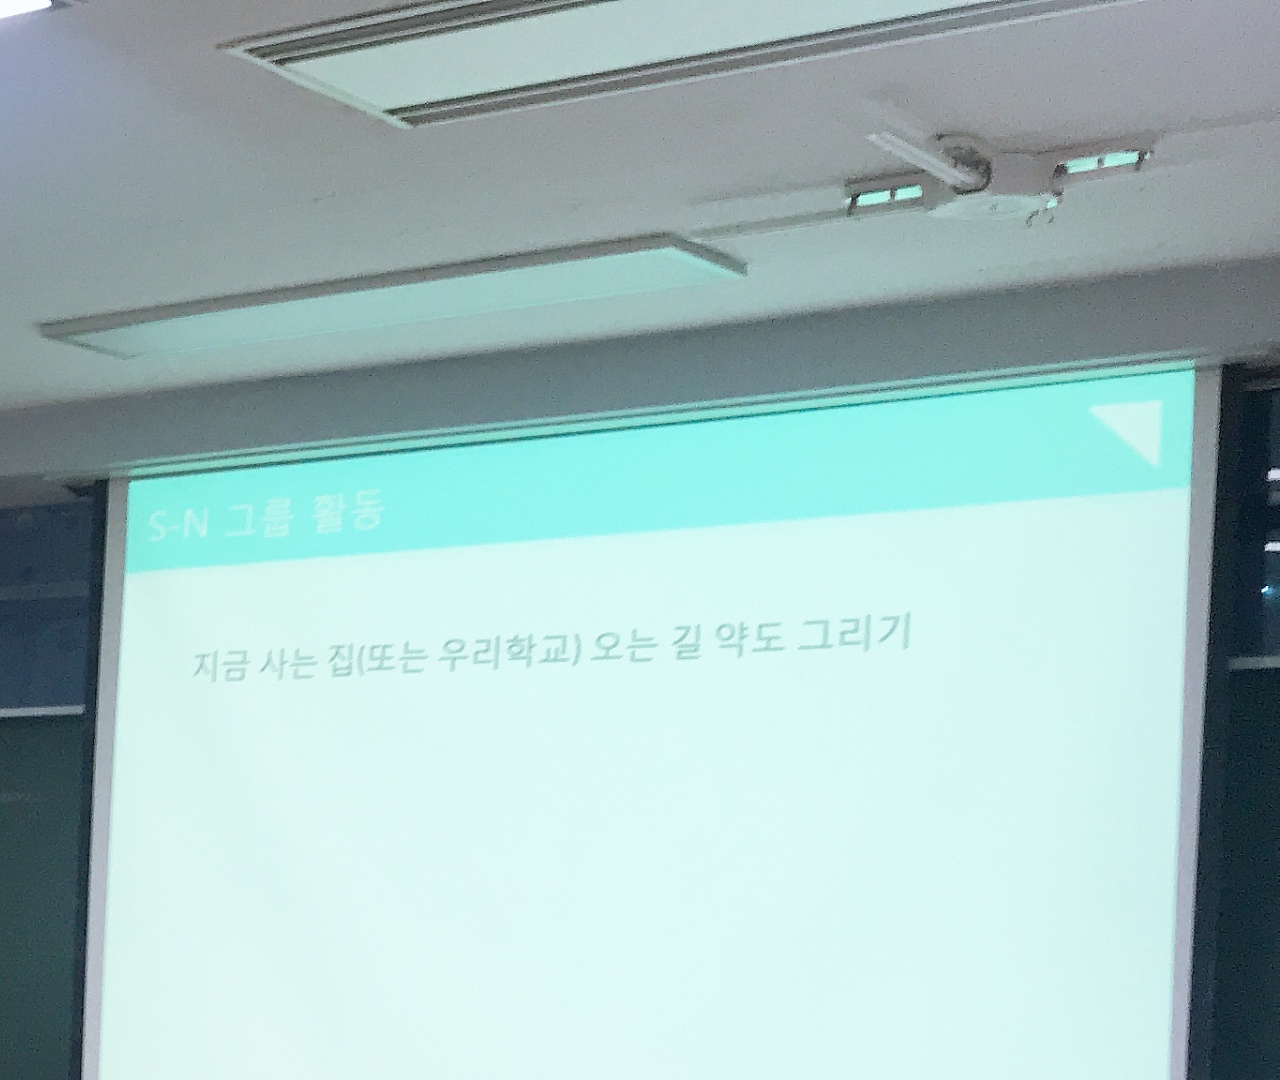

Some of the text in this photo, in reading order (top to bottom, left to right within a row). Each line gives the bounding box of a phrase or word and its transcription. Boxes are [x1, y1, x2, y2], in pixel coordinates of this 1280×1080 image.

[224, 497, 293, 538] 그룹
[313, 488, 385, 535] 활동
[192, 611, 911, 683] 지금 사는 집(또는 우리학교) 오는 길 약도 그리기
